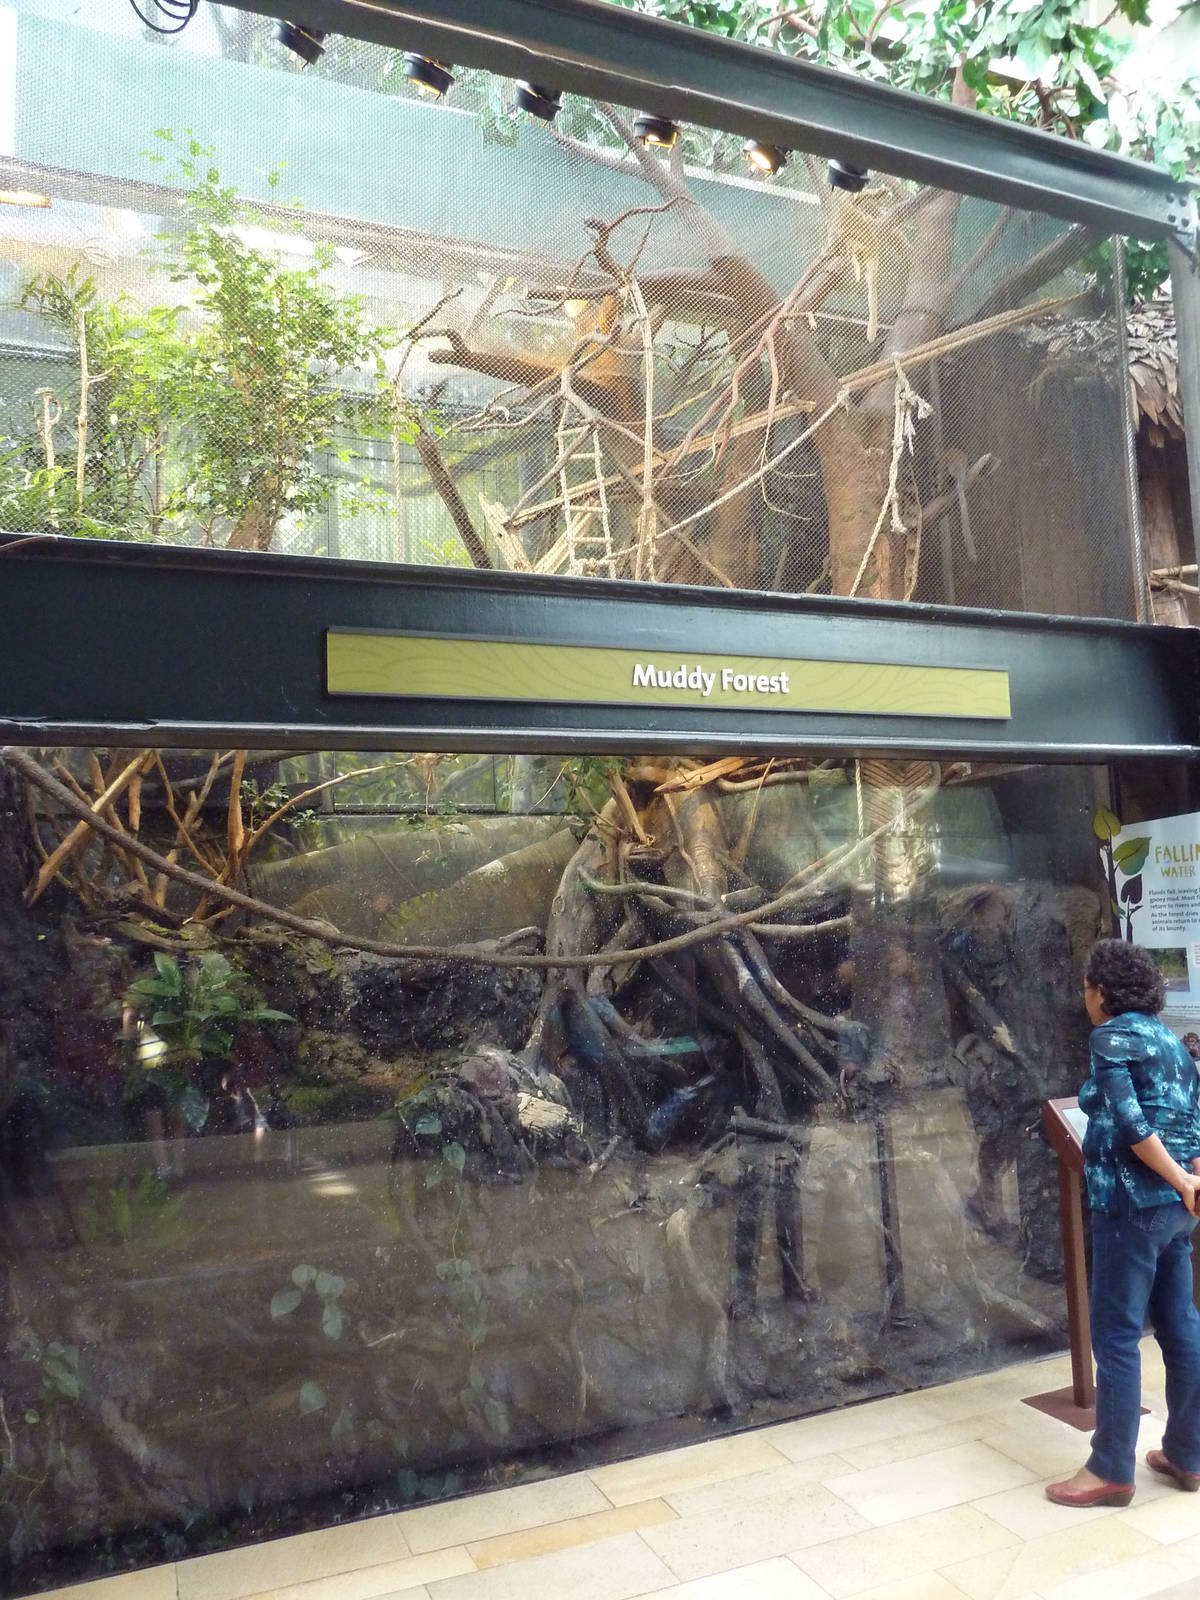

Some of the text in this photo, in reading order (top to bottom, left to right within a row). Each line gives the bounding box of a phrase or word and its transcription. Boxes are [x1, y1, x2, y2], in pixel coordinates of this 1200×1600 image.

[632, 663, 790, 697] Muddy Forest
[1160, 865, 1196, 879] WATER
